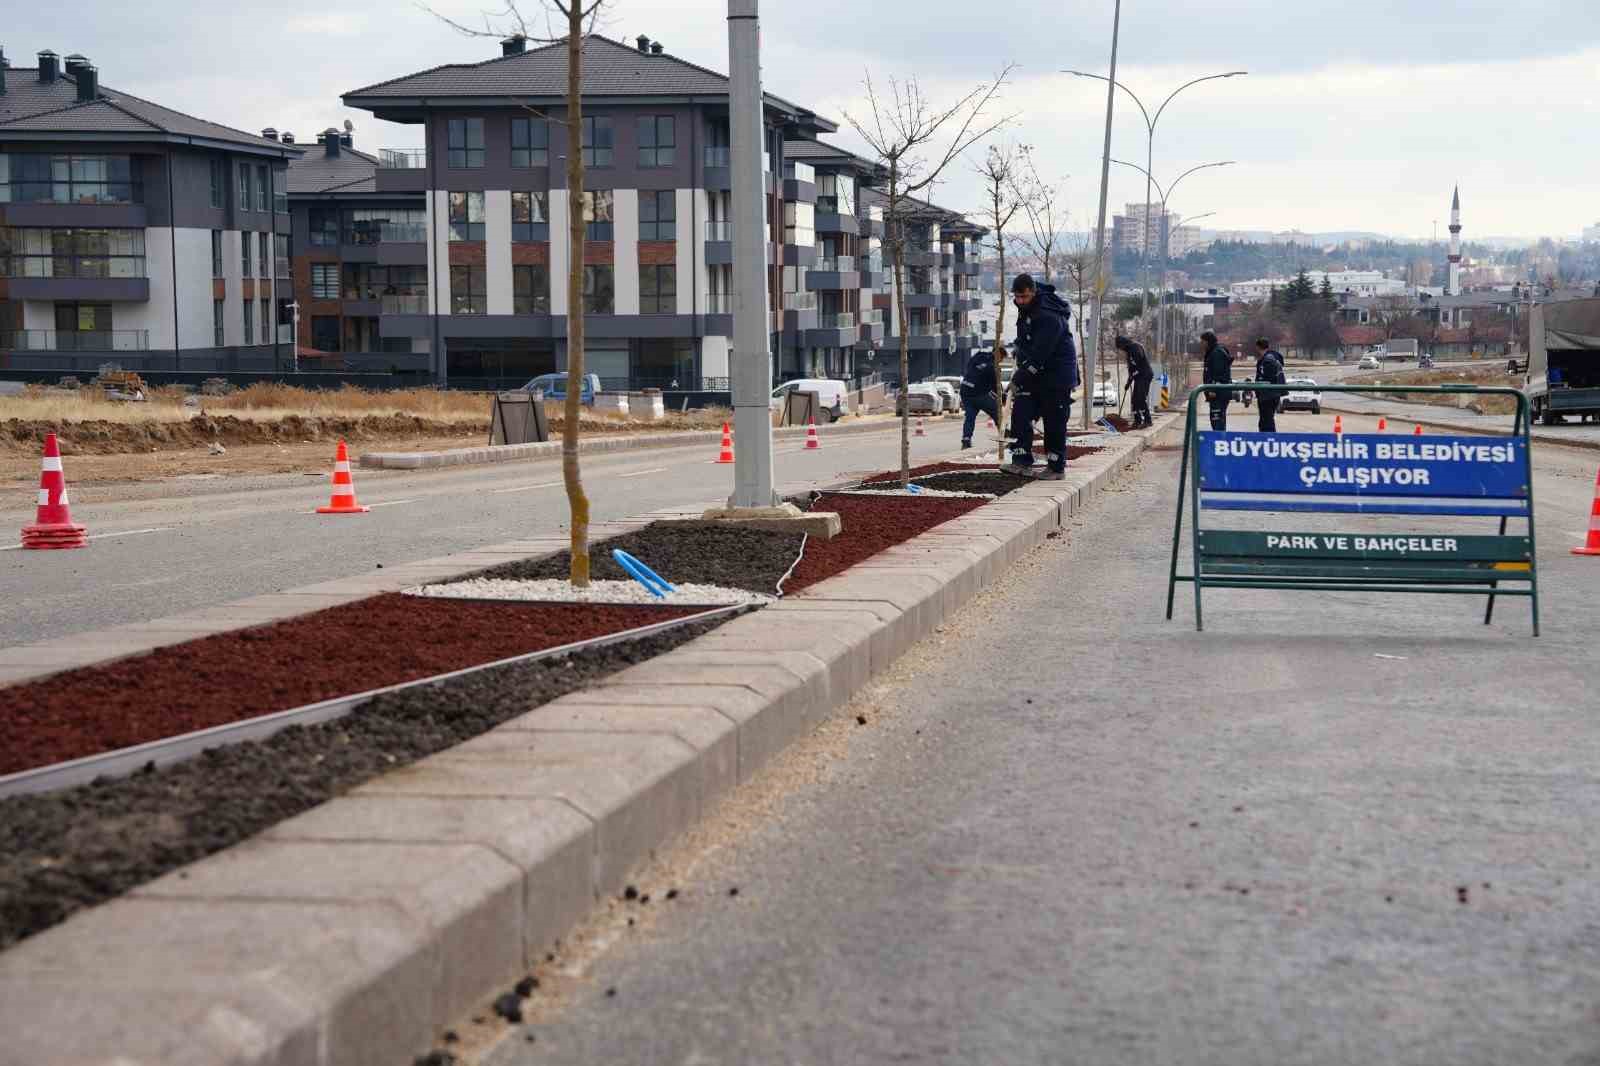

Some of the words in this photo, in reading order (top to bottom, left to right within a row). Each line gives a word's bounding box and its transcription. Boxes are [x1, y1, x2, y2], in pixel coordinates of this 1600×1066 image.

[1214, 438, 1369, 463] BÜYÜKŞEHİR
[1376, 441, 1515, 463] BELEDİYESİ
[1300, 467, 1430, 488] ÇALIŞIYOR
[1267, 535, 1318, 550] PARK
[1323, 536, 1349, 551] VE
[1355, 537, 1457, 554] BAHÇELER
